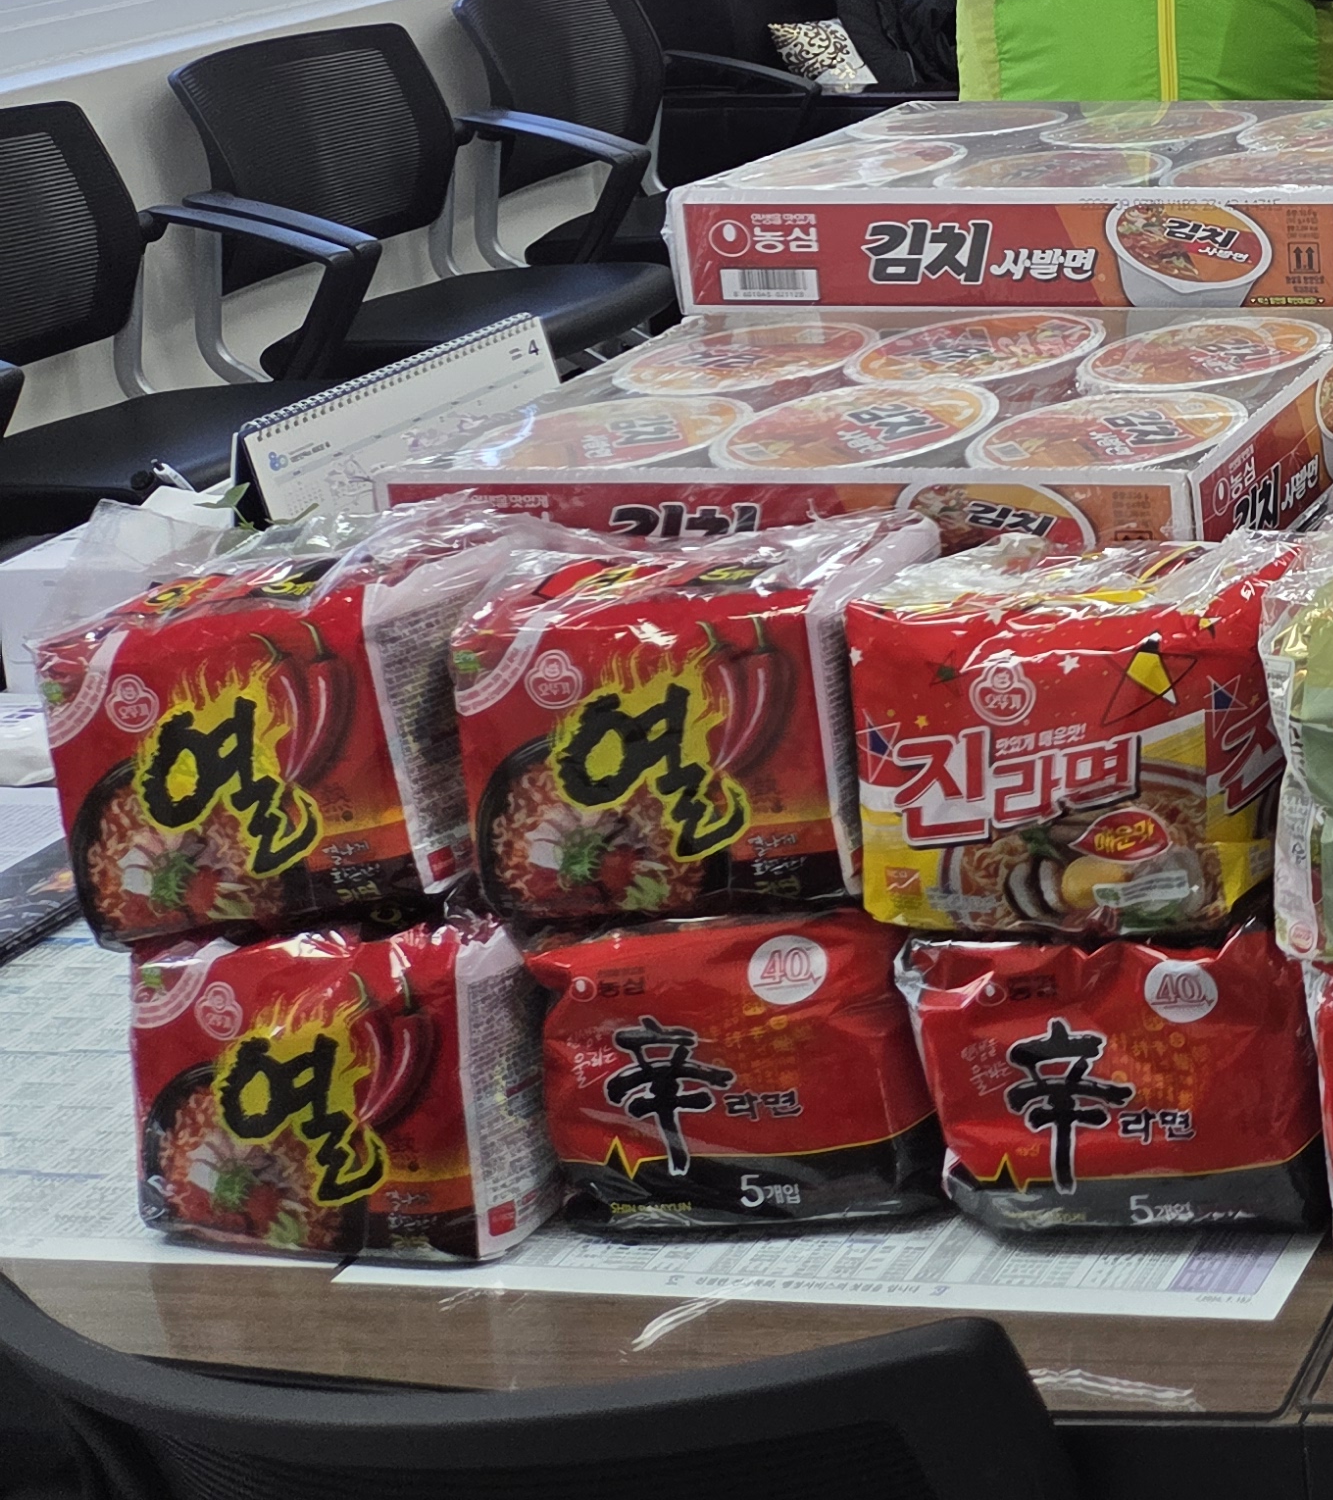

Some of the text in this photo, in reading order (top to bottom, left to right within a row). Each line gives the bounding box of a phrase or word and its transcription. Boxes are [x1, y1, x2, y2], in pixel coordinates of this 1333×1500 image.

[753, 226, 819, 253] 농심
[861, 219, 1098, 284] 김치 사발면
[1163, 217, 1241, 249] 김치
[527, 339, 540, 357] 4
[1102, 408, 1196, 447] 김치
[1229, 458, 1257, 502] 농심
[1280, 453, 1321, 512] 사발면
[965, 500, 1057, 538] 김치
[140, 695, 322, 876] 열
[557, 682, 748, 860] 열
[894, 726, 1141, 850] 진라면
[1094, 818, 1154, 853] 매운맛
[759, 946, 812, 984] 40
[1154, 974, 1202, 1005] 40
[604, 1015, 736, 1177] 辛
[722, 1089, 803, 1122] 라면
[1003, 1016, 1136, 1196] 辛
[219, 1032, 388, 1202] 열
[1117, 1108, 1197, 1144] 라면
[739, 1174, 801, 1208] 5개입
[1129, 1193, 1195, 1223] 5개입
